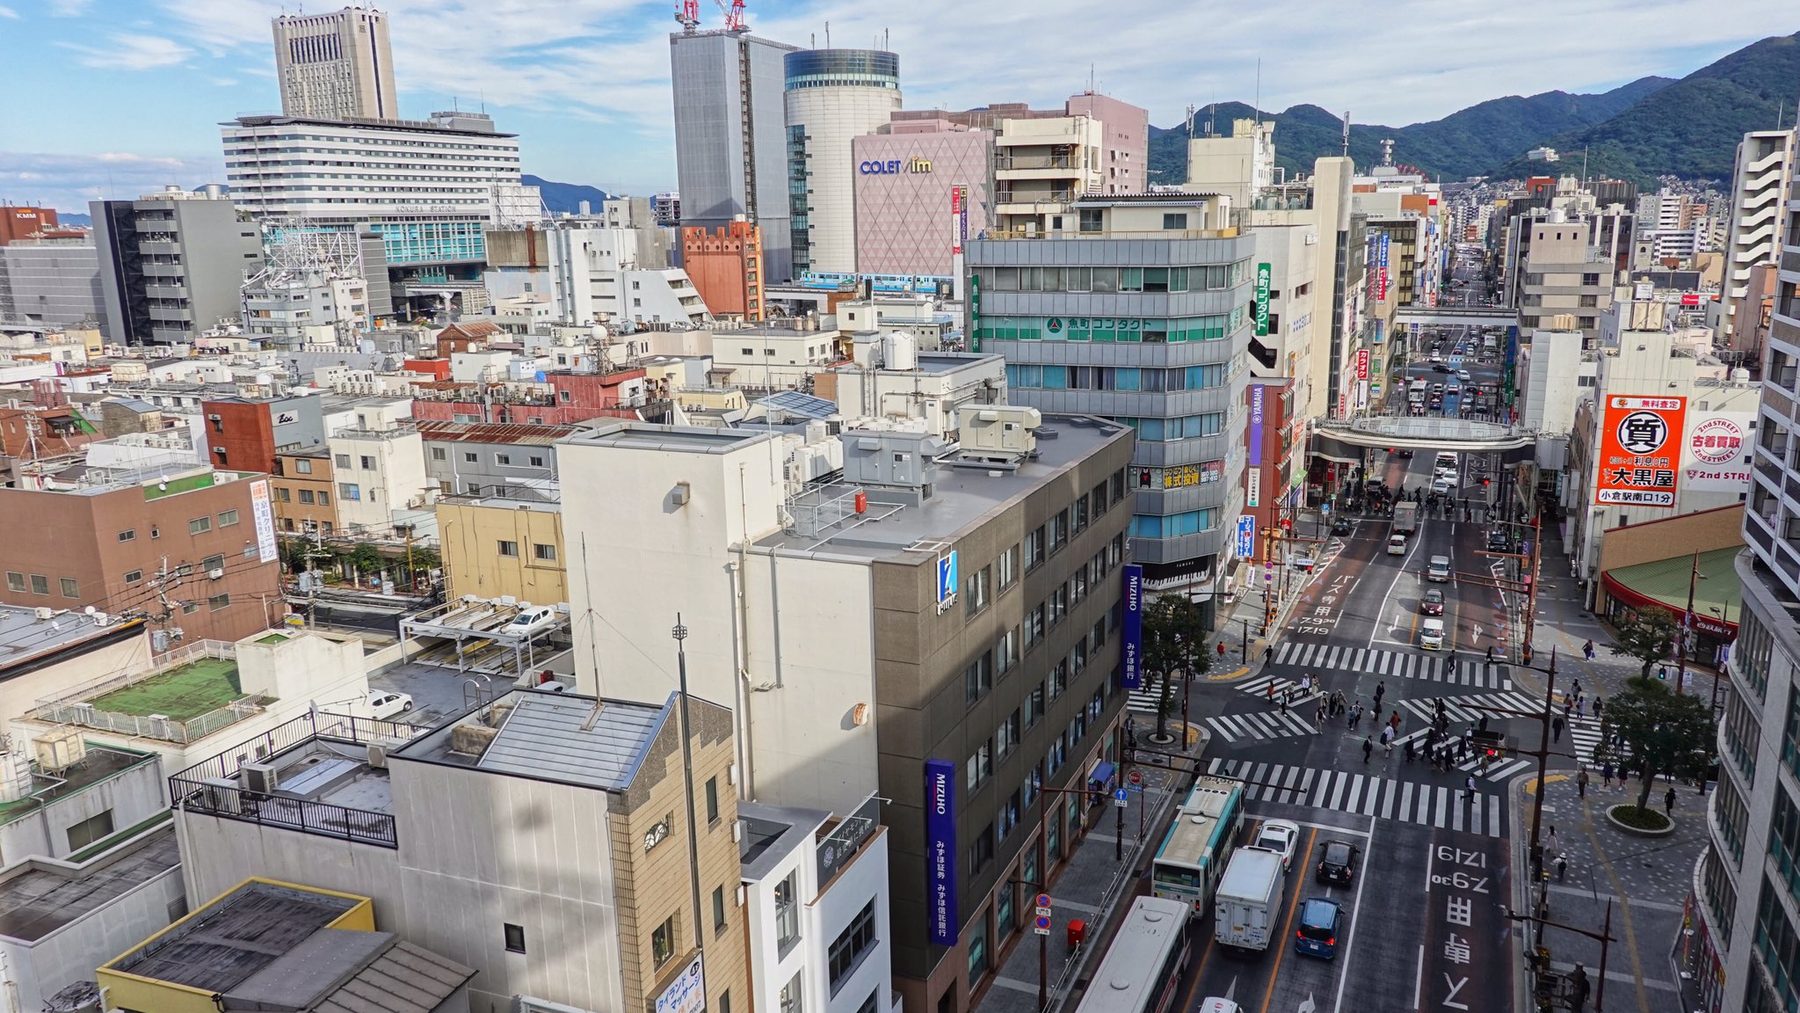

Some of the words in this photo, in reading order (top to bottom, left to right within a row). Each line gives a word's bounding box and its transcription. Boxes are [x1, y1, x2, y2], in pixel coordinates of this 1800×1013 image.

[860, 160, 901, 175] COLET
[395, 205, 424, 213] KOKURA
[430, 205, 457, 213] STATION
[1258, 269, 1270, 331] 魚町コンタクト
[1067, 319, 1152, 330] 魚町コンタクト
[1359, 351, 1367, 377] カラオケ
[1252, 387, 1263, 415] YAMAHA
[1641, 400, 1679, 409] 無料査定
[1624, 418, 1662, 448] 質
[1692, 435, 1741, 449] 古着買取
[1164, 470, 1200, 489] 株式投資
[1611, 467, 1674, 487] 大黒屋
[1699, 471, 1721, 480] 2nd
[1600, 490, 1672, 503] 小倉駅南口1分
[1129, 575, 1138, 611] MIZUHO
[1126, 642, 1136, 680] みずほ銀行
[936, 773, 946, 815] MIZUHO
[936, 840, 945, 879] みずほ証券
[937, 883, 946, 937] みずほ信託銀行
[657, 974, 687, 1012] タイランド
[670, 974, 701, 1010] マッサージ
